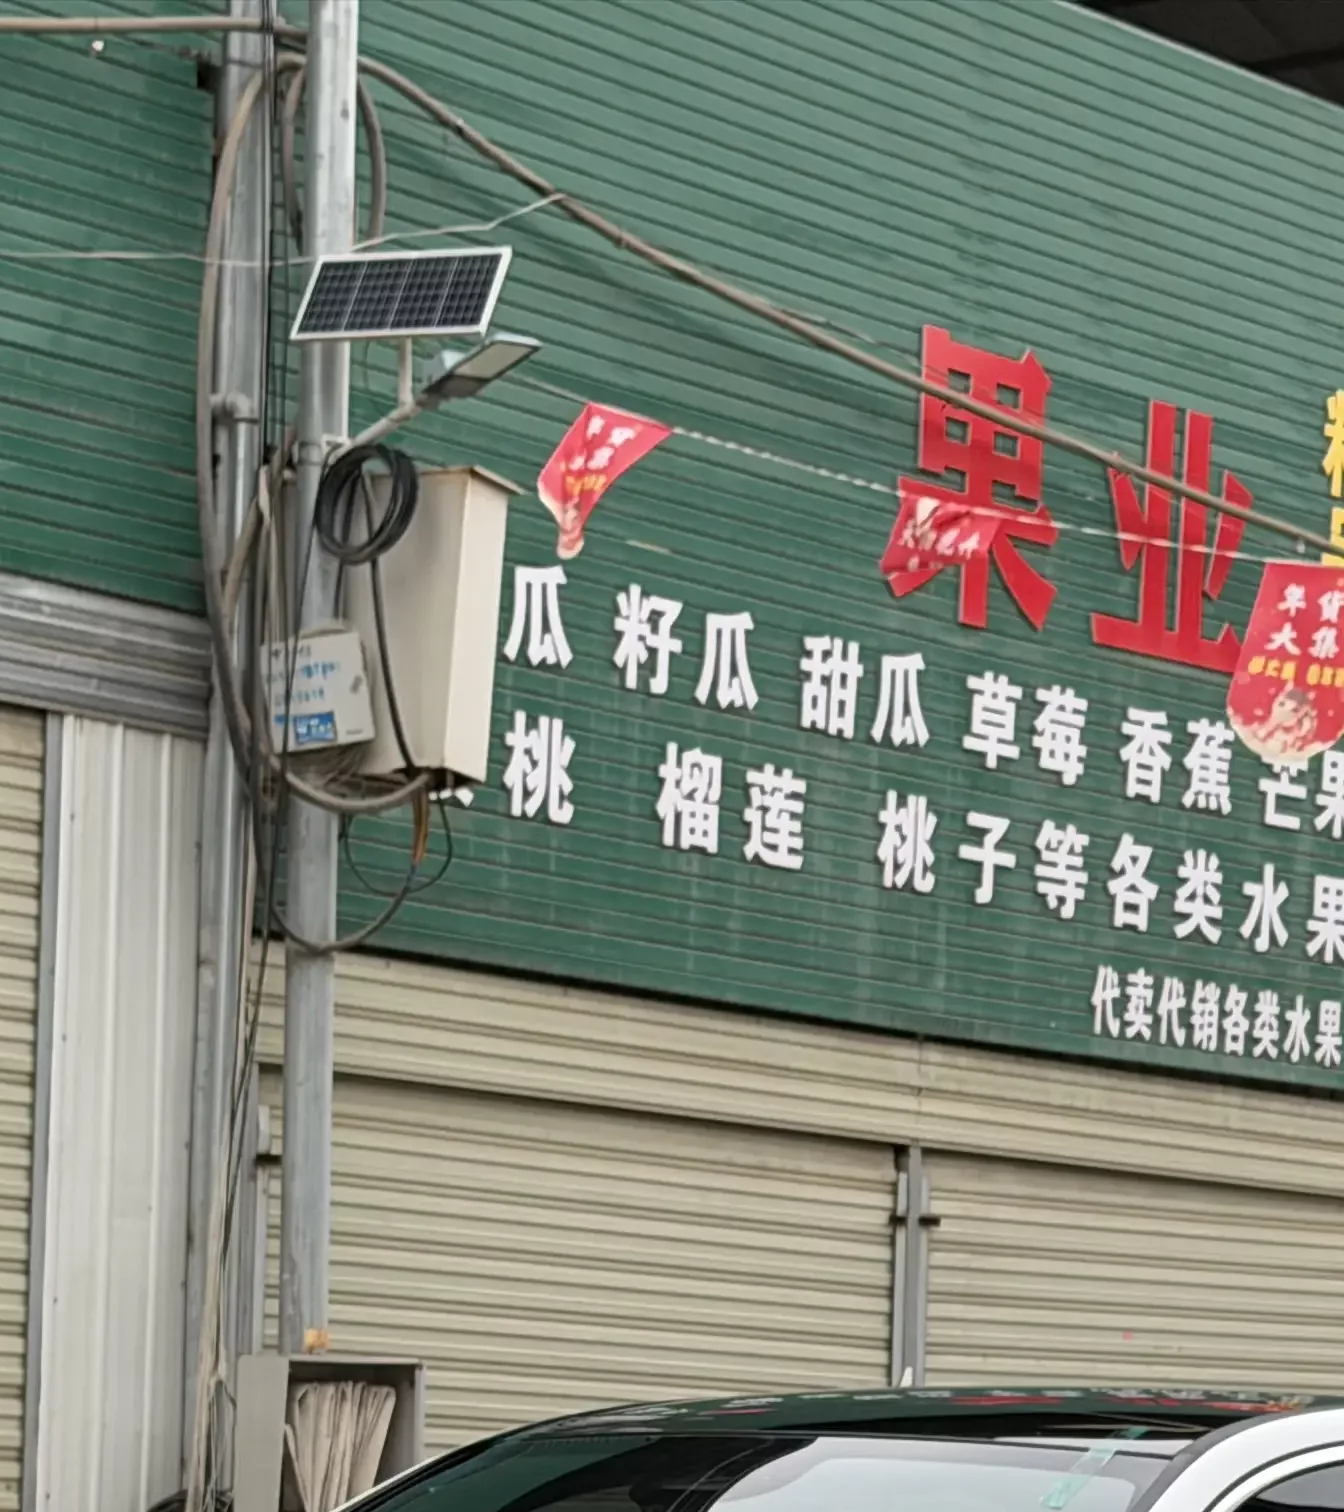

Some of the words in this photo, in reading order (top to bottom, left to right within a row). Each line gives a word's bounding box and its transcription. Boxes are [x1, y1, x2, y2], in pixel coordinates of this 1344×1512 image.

[613, 583, 759, 711] 籽瓜
[800, 634, 931, 748] 甜瓜
[958, 669, 1090, 787] 草莓
[1119, 706, 1236, 818] 香蕉
[655, 741, 808, 871] 榴莲
[1090, 964, 1344, 1068] 代卖代销各类水果
